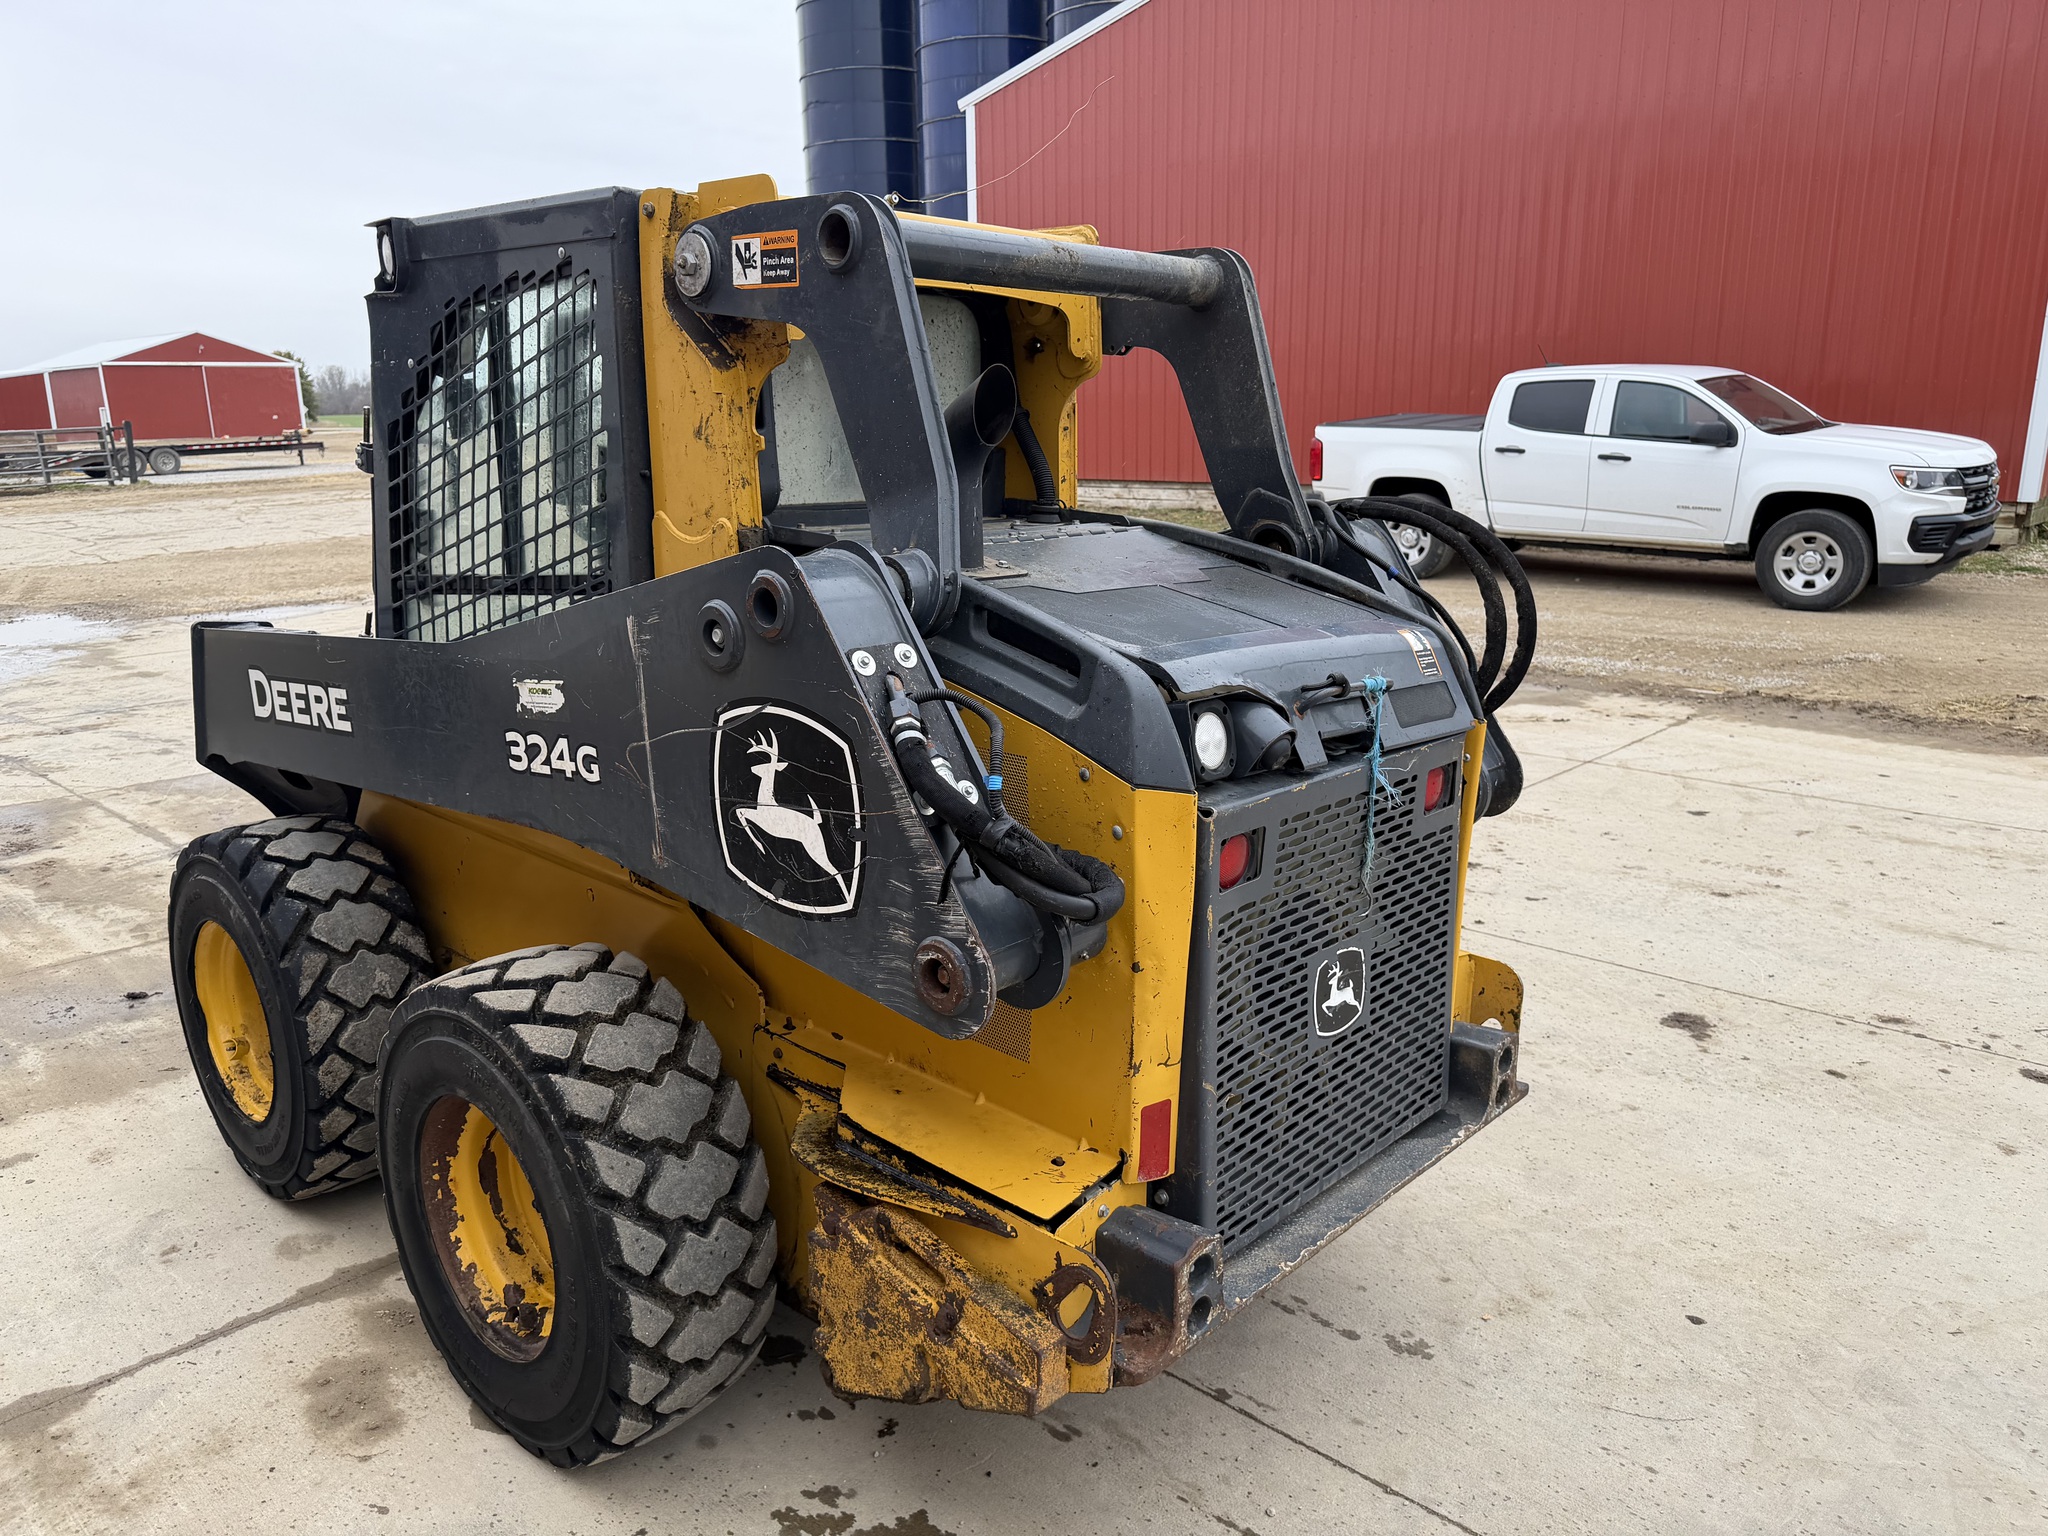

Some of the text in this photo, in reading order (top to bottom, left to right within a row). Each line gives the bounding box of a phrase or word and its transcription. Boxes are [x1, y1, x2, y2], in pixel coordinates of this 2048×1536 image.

[768, 235, 795, 244] WARNING
[763, 256, 794, 265] Pinch Area
[776, 269, 790, 277] Away
[248, 669, 352, 732] DEERE
[505, 731, 600, 782] 324G
